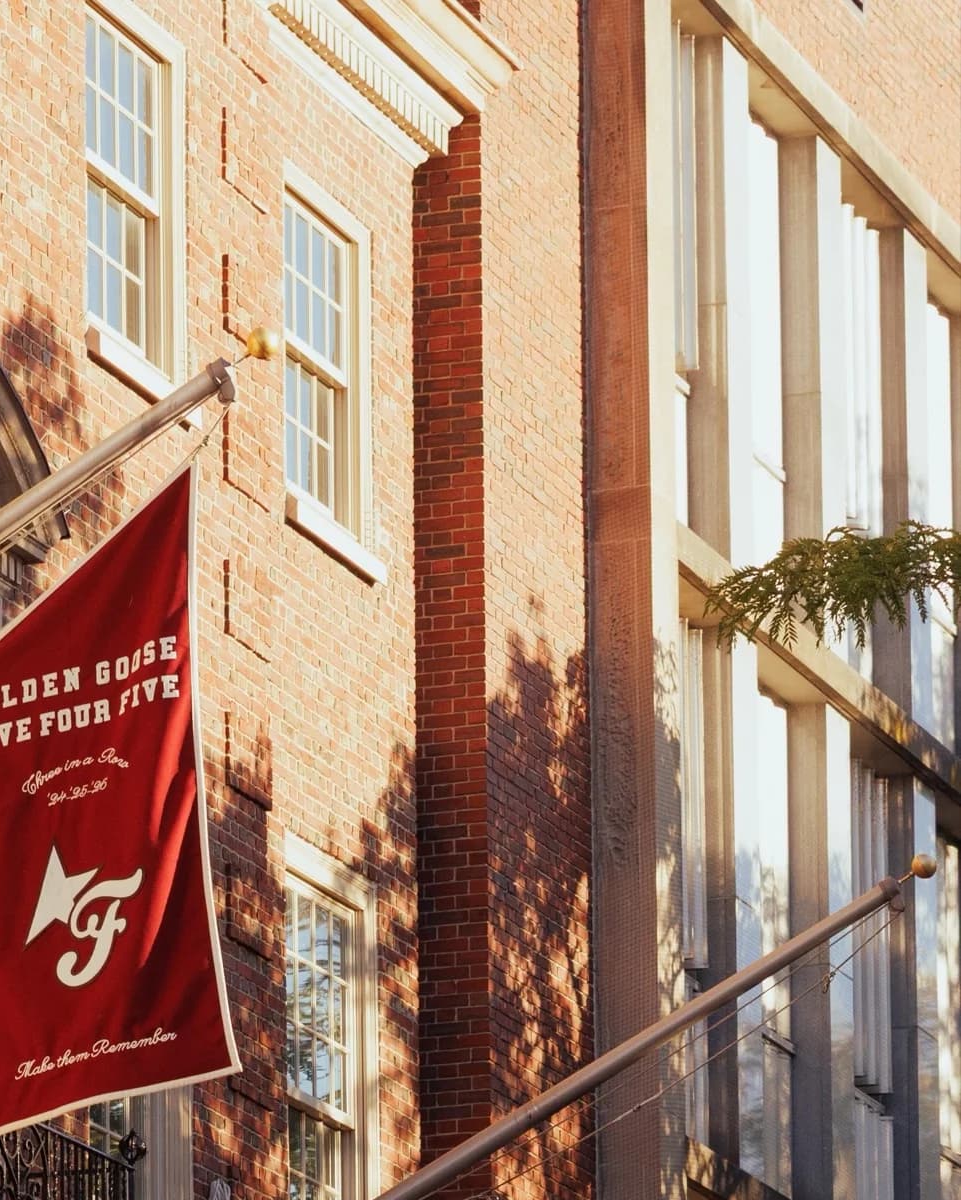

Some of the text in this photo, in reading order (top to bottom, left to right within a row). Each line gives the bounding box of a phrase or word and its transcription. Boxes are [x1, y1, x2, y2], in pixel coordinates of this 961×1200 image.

[94, 635, 178, 686] GOOSE
[39, 698, 111, 738] FOUR
[118, 673, 180, 717] FIVE
[21, 747, 130, 795] Three in a Row
[14, 1026, 178, 1081] Make them Remember
